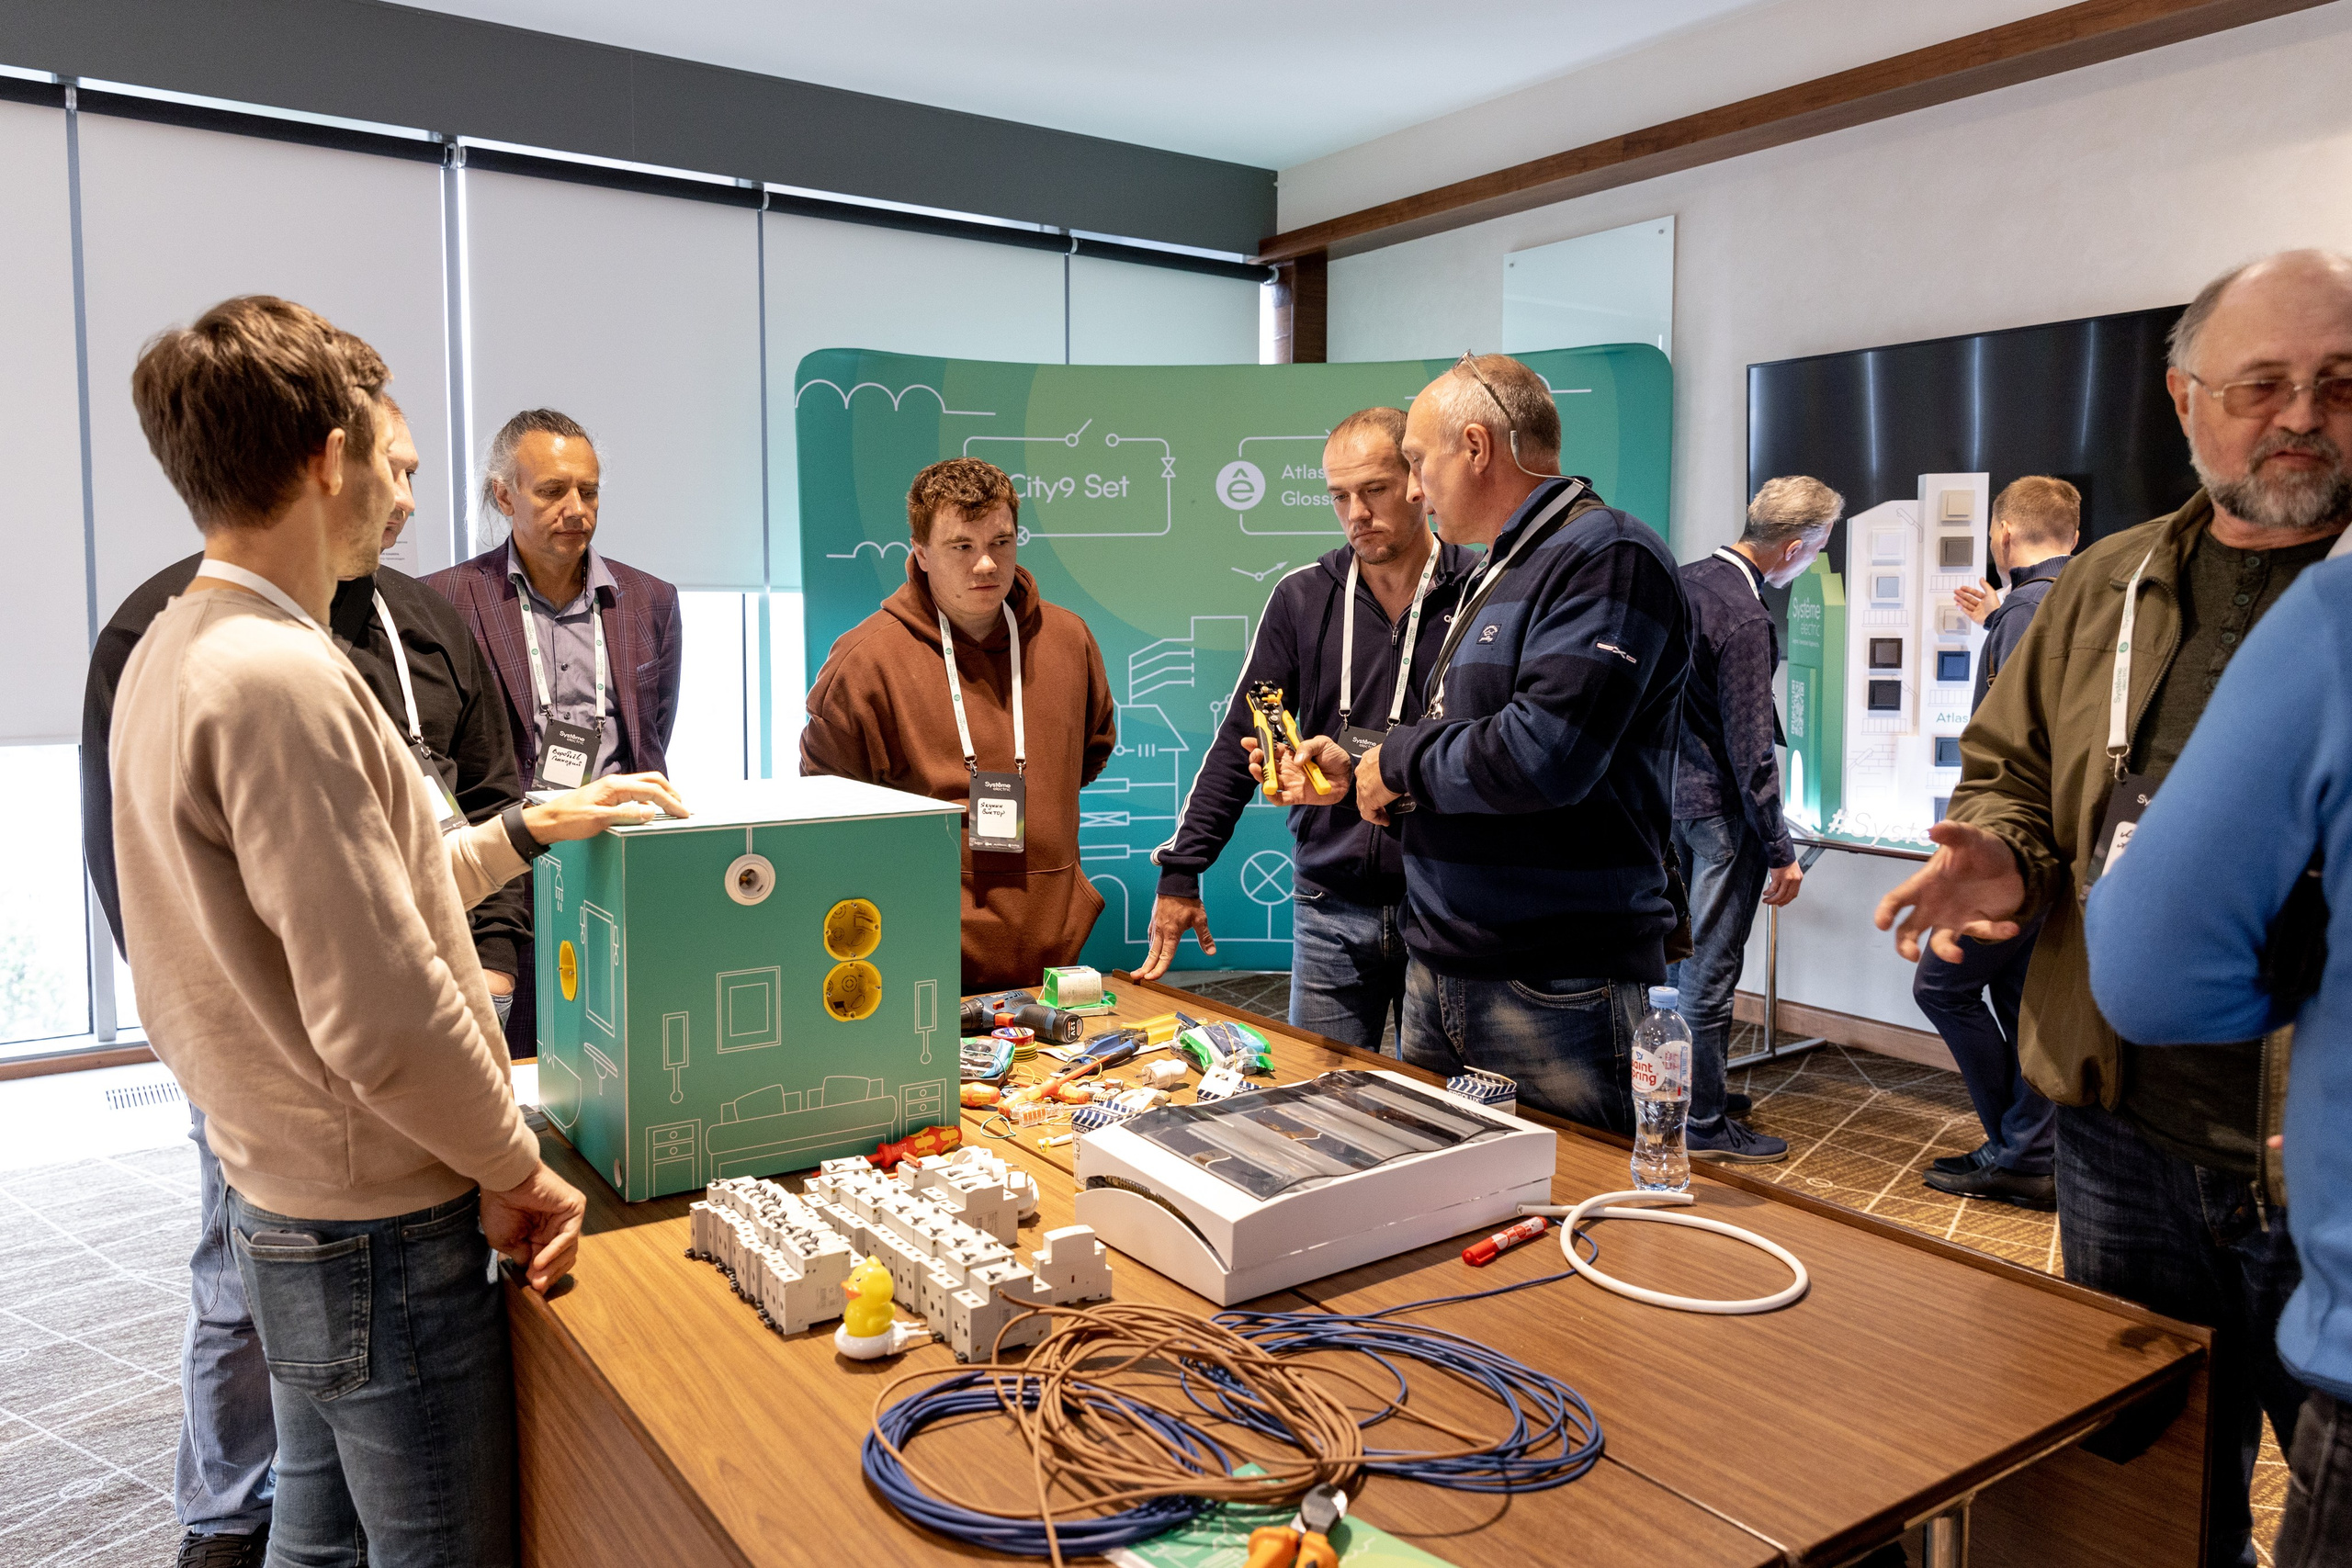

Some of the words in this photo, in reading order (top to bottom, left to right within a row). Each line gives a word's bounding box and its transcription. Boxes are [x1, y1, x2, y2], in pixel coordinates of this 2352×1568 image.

[1010, 473, 1075, 503] City9
[1084, 473, 1130, 498] Set
[1936, 712, 1969, 723] Atlas
[1827, 808, 1940, 848] #Syste
[1632, 1070, 1657, 1087] pring
